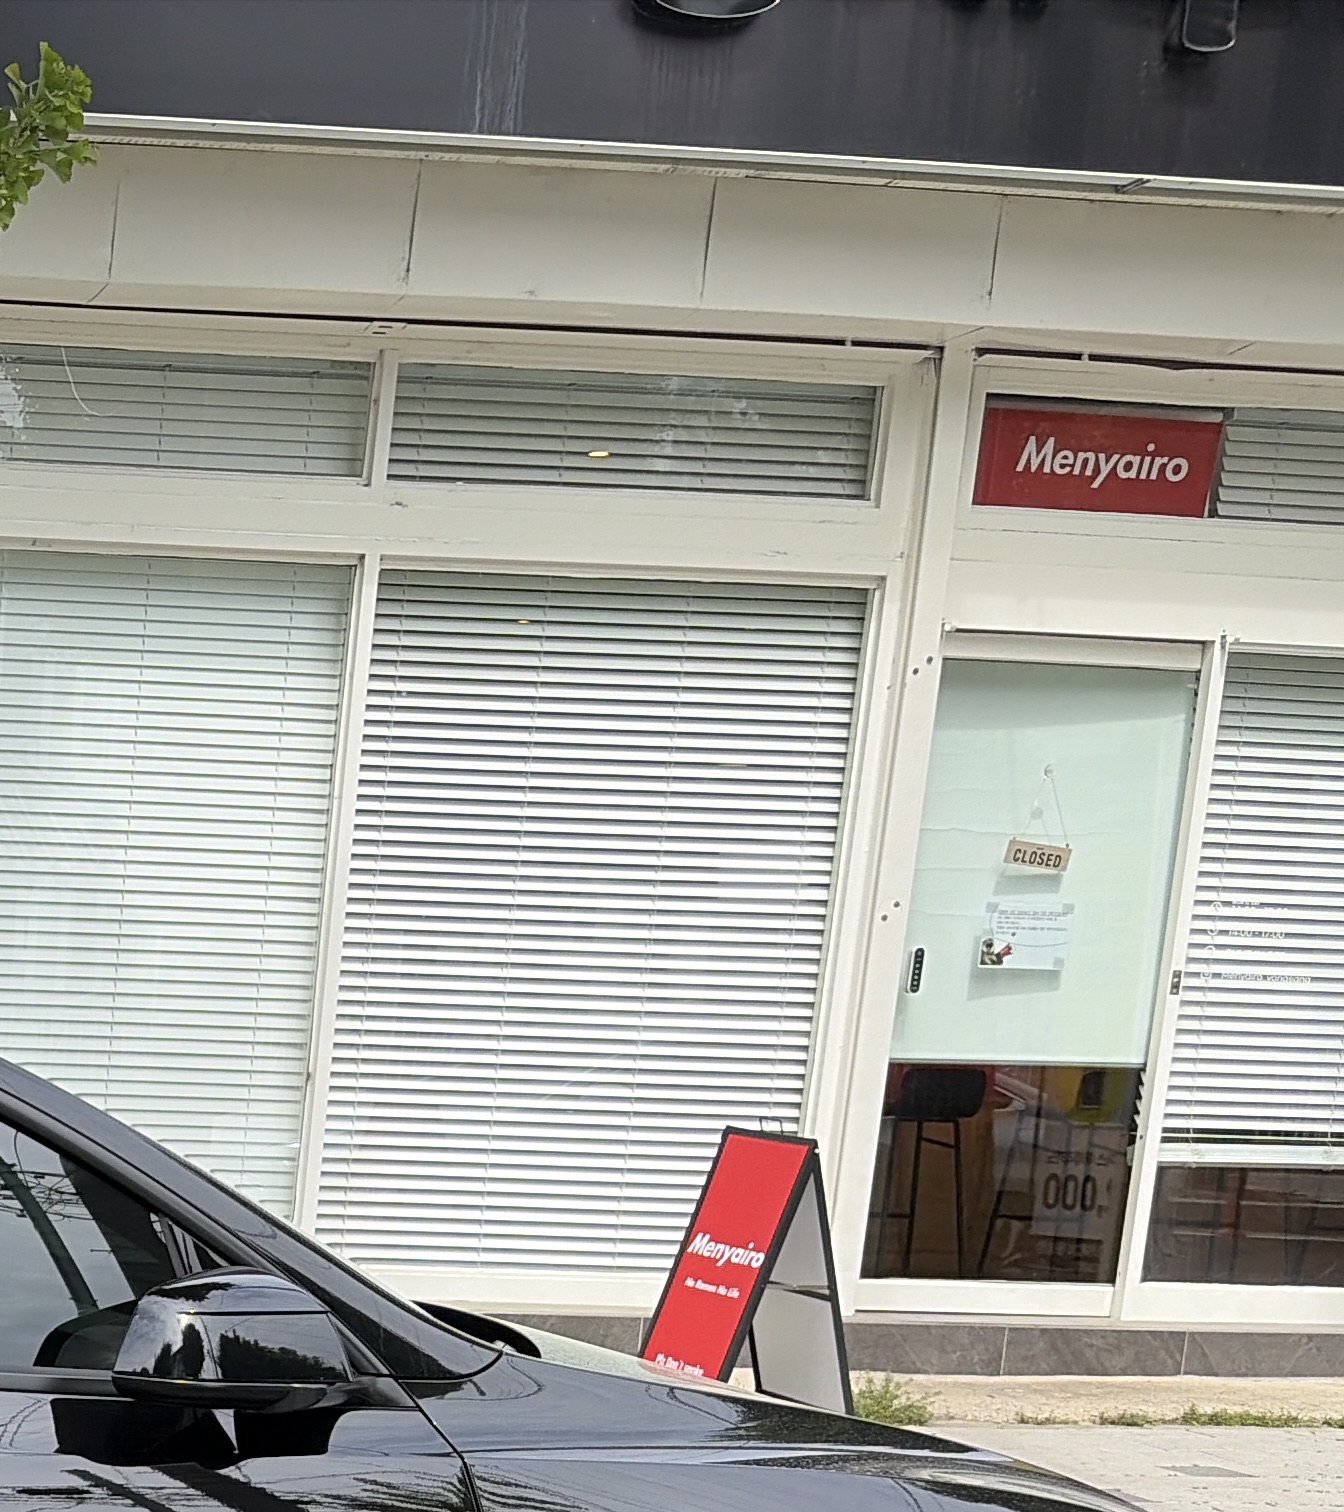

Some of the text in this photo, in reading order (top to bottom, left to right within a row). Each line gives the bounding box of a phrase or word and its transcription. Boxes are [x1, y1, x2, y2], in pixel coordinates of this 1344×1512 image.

[1016, 435, 1189, 489] Menyairo
[1012, 848, 1062, 868] CLOSED
[686, 1232, 765, 1269] Menyairo
